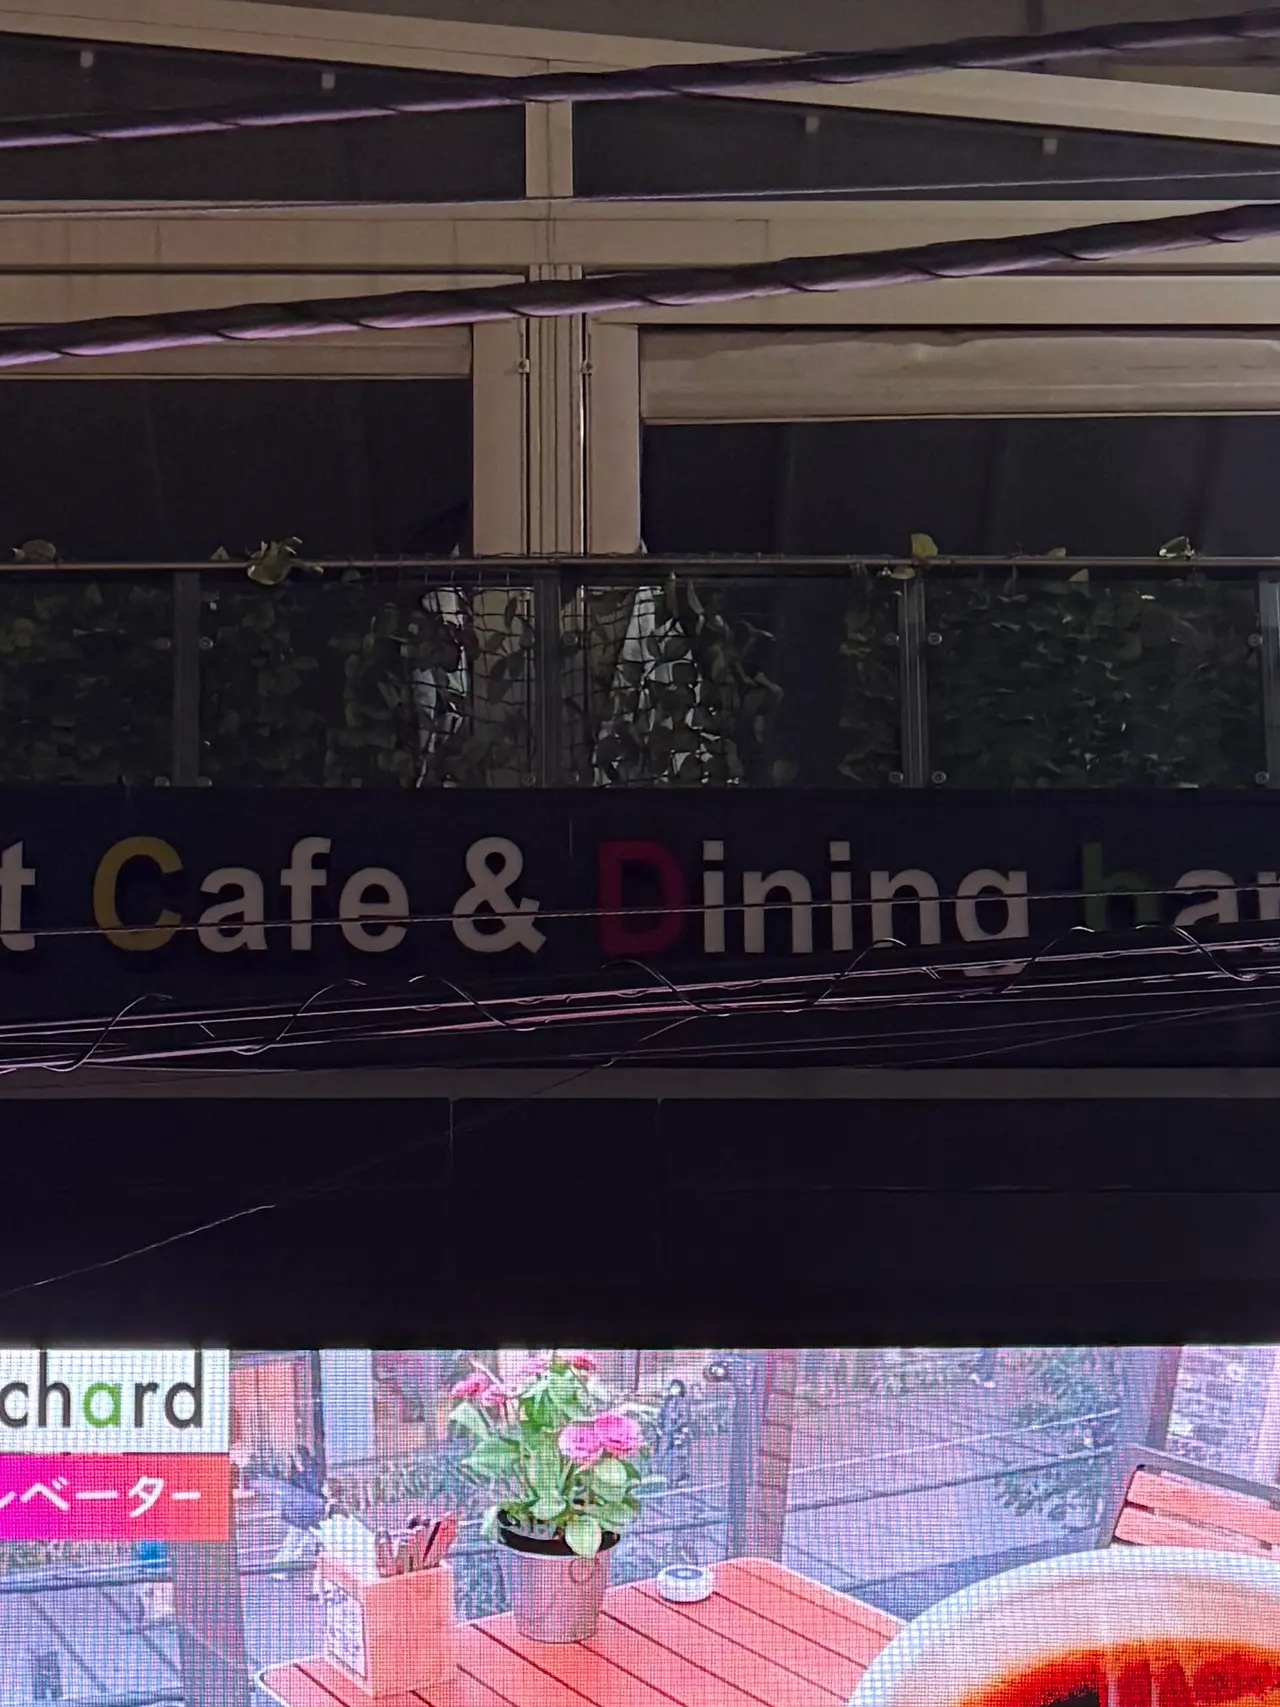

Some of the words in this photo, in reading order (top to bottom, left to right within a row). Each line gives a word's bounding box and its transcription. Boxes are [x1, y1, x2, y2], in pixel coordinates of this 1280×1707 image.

[93, 835, 411, 953] Cafe
[452, 835, 548, 954] &
[597, 839, 1030, 977] Dining
